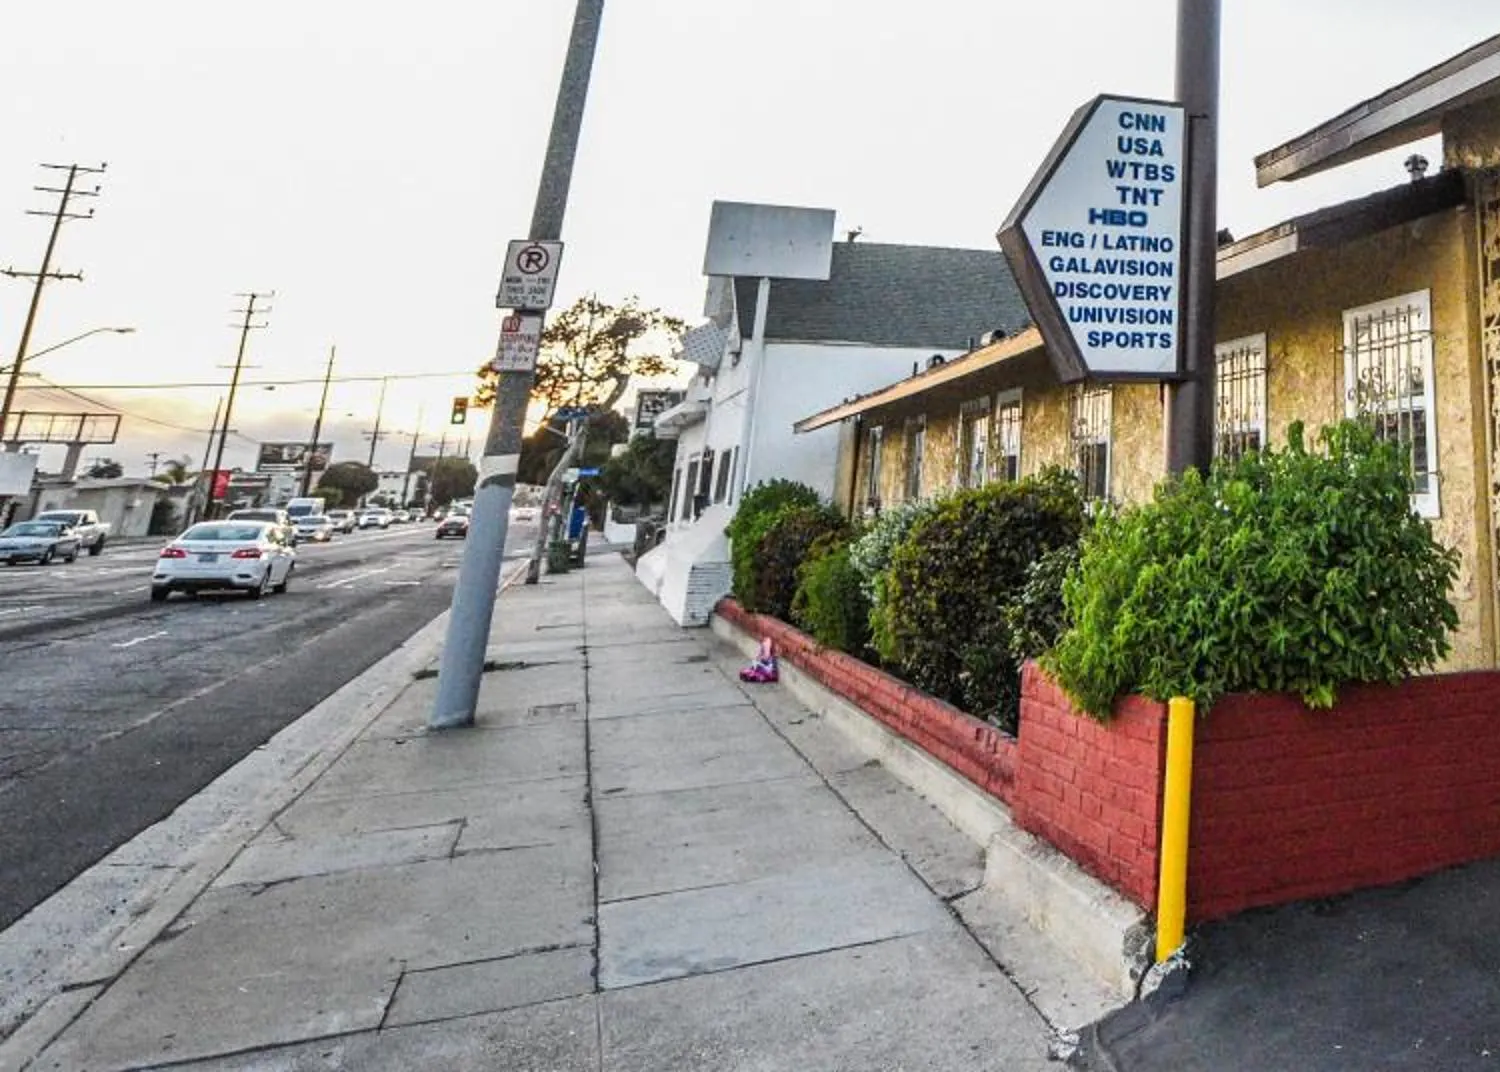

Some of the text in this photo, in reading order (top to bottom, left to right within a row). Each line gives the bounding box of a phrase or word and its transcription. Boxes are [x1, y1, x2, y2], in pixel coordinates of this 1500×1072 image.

[1118, 112, 1166, 133] CNN
[1117, 136, 1164, 157] USA
[1106, 159, 1176, 183] WTBS
[1116, 186, 1164, 207] TNT
[1088, 208, 1148, 227] HBO
[1041, 231, 1085, 249] ENG
[1103, 234, 1174, 253] LATINO
[1049, 256, 1173, 277] GALAVISION
[1055, 281, 1172, 301] DISCOVERY
[1069, 306, 1173, 325] UNIVISION
[1087, 331, 1172, 349] SPORTS
